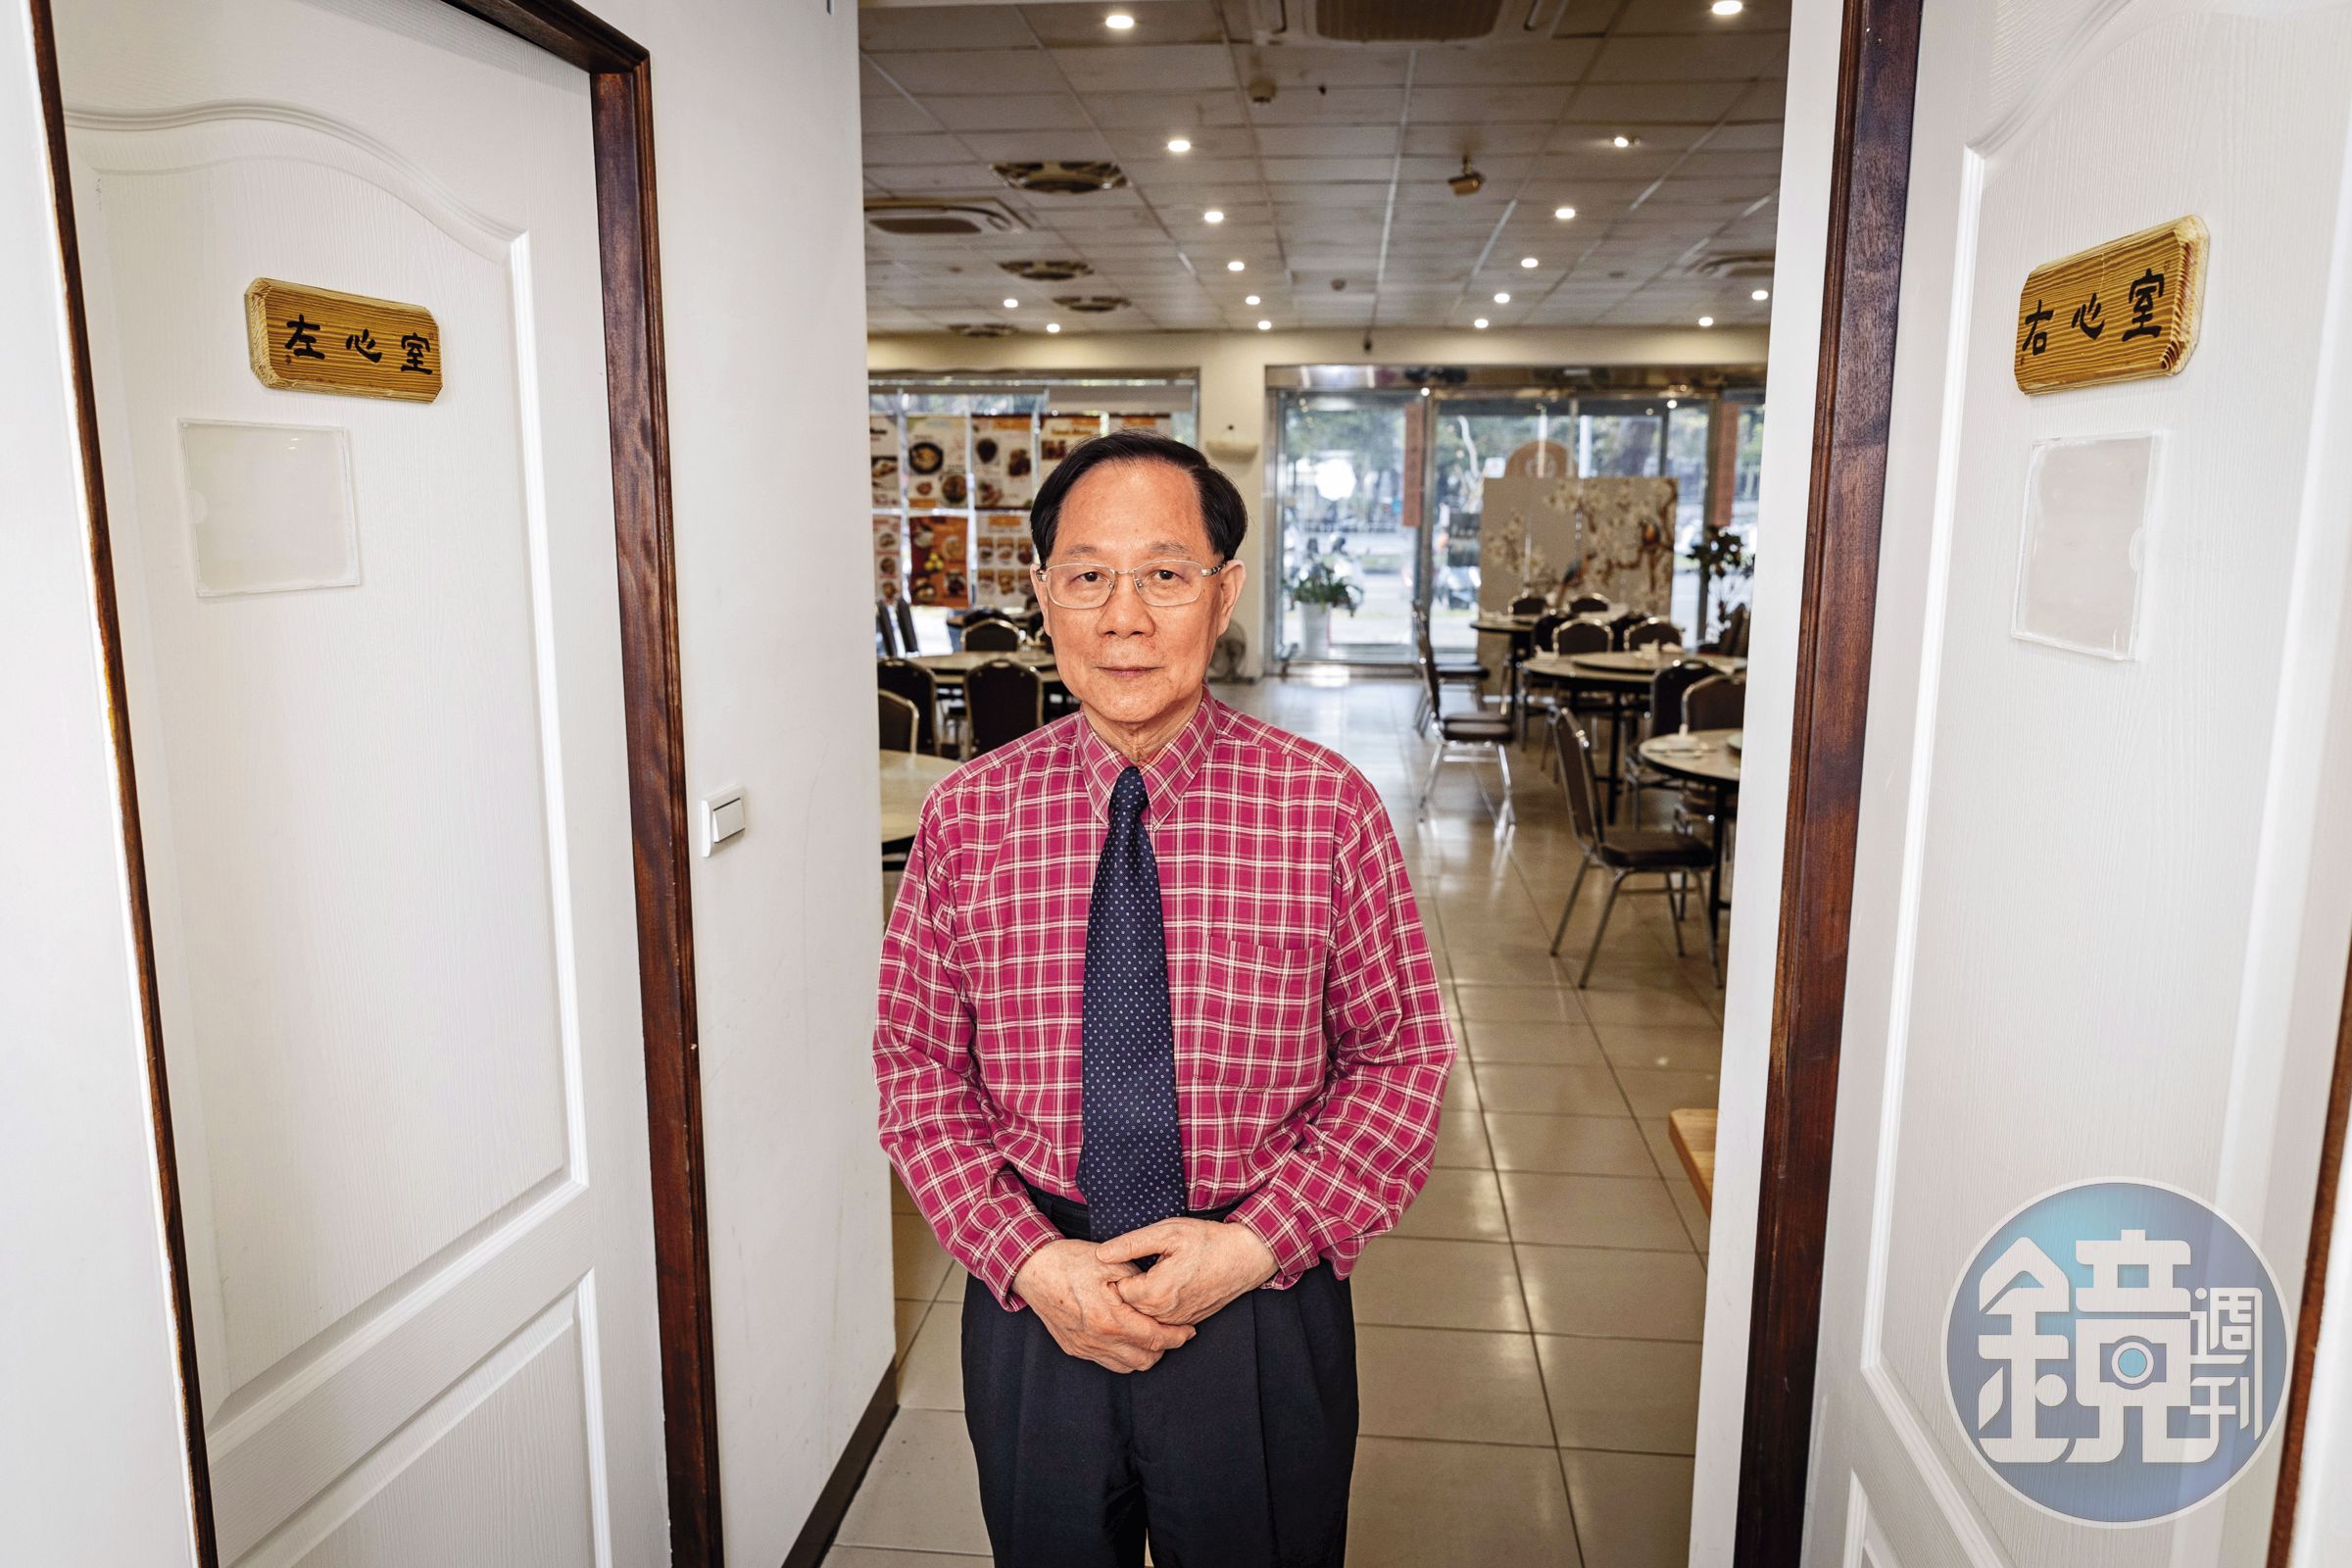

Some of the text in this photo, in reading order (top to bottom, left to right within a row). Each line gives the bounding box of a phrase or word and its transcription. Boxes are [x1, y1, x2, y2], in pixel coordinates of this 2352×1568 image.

[284, 314, 433, 375] 左心室
[2022, 268, 2165, 357] 右心室
